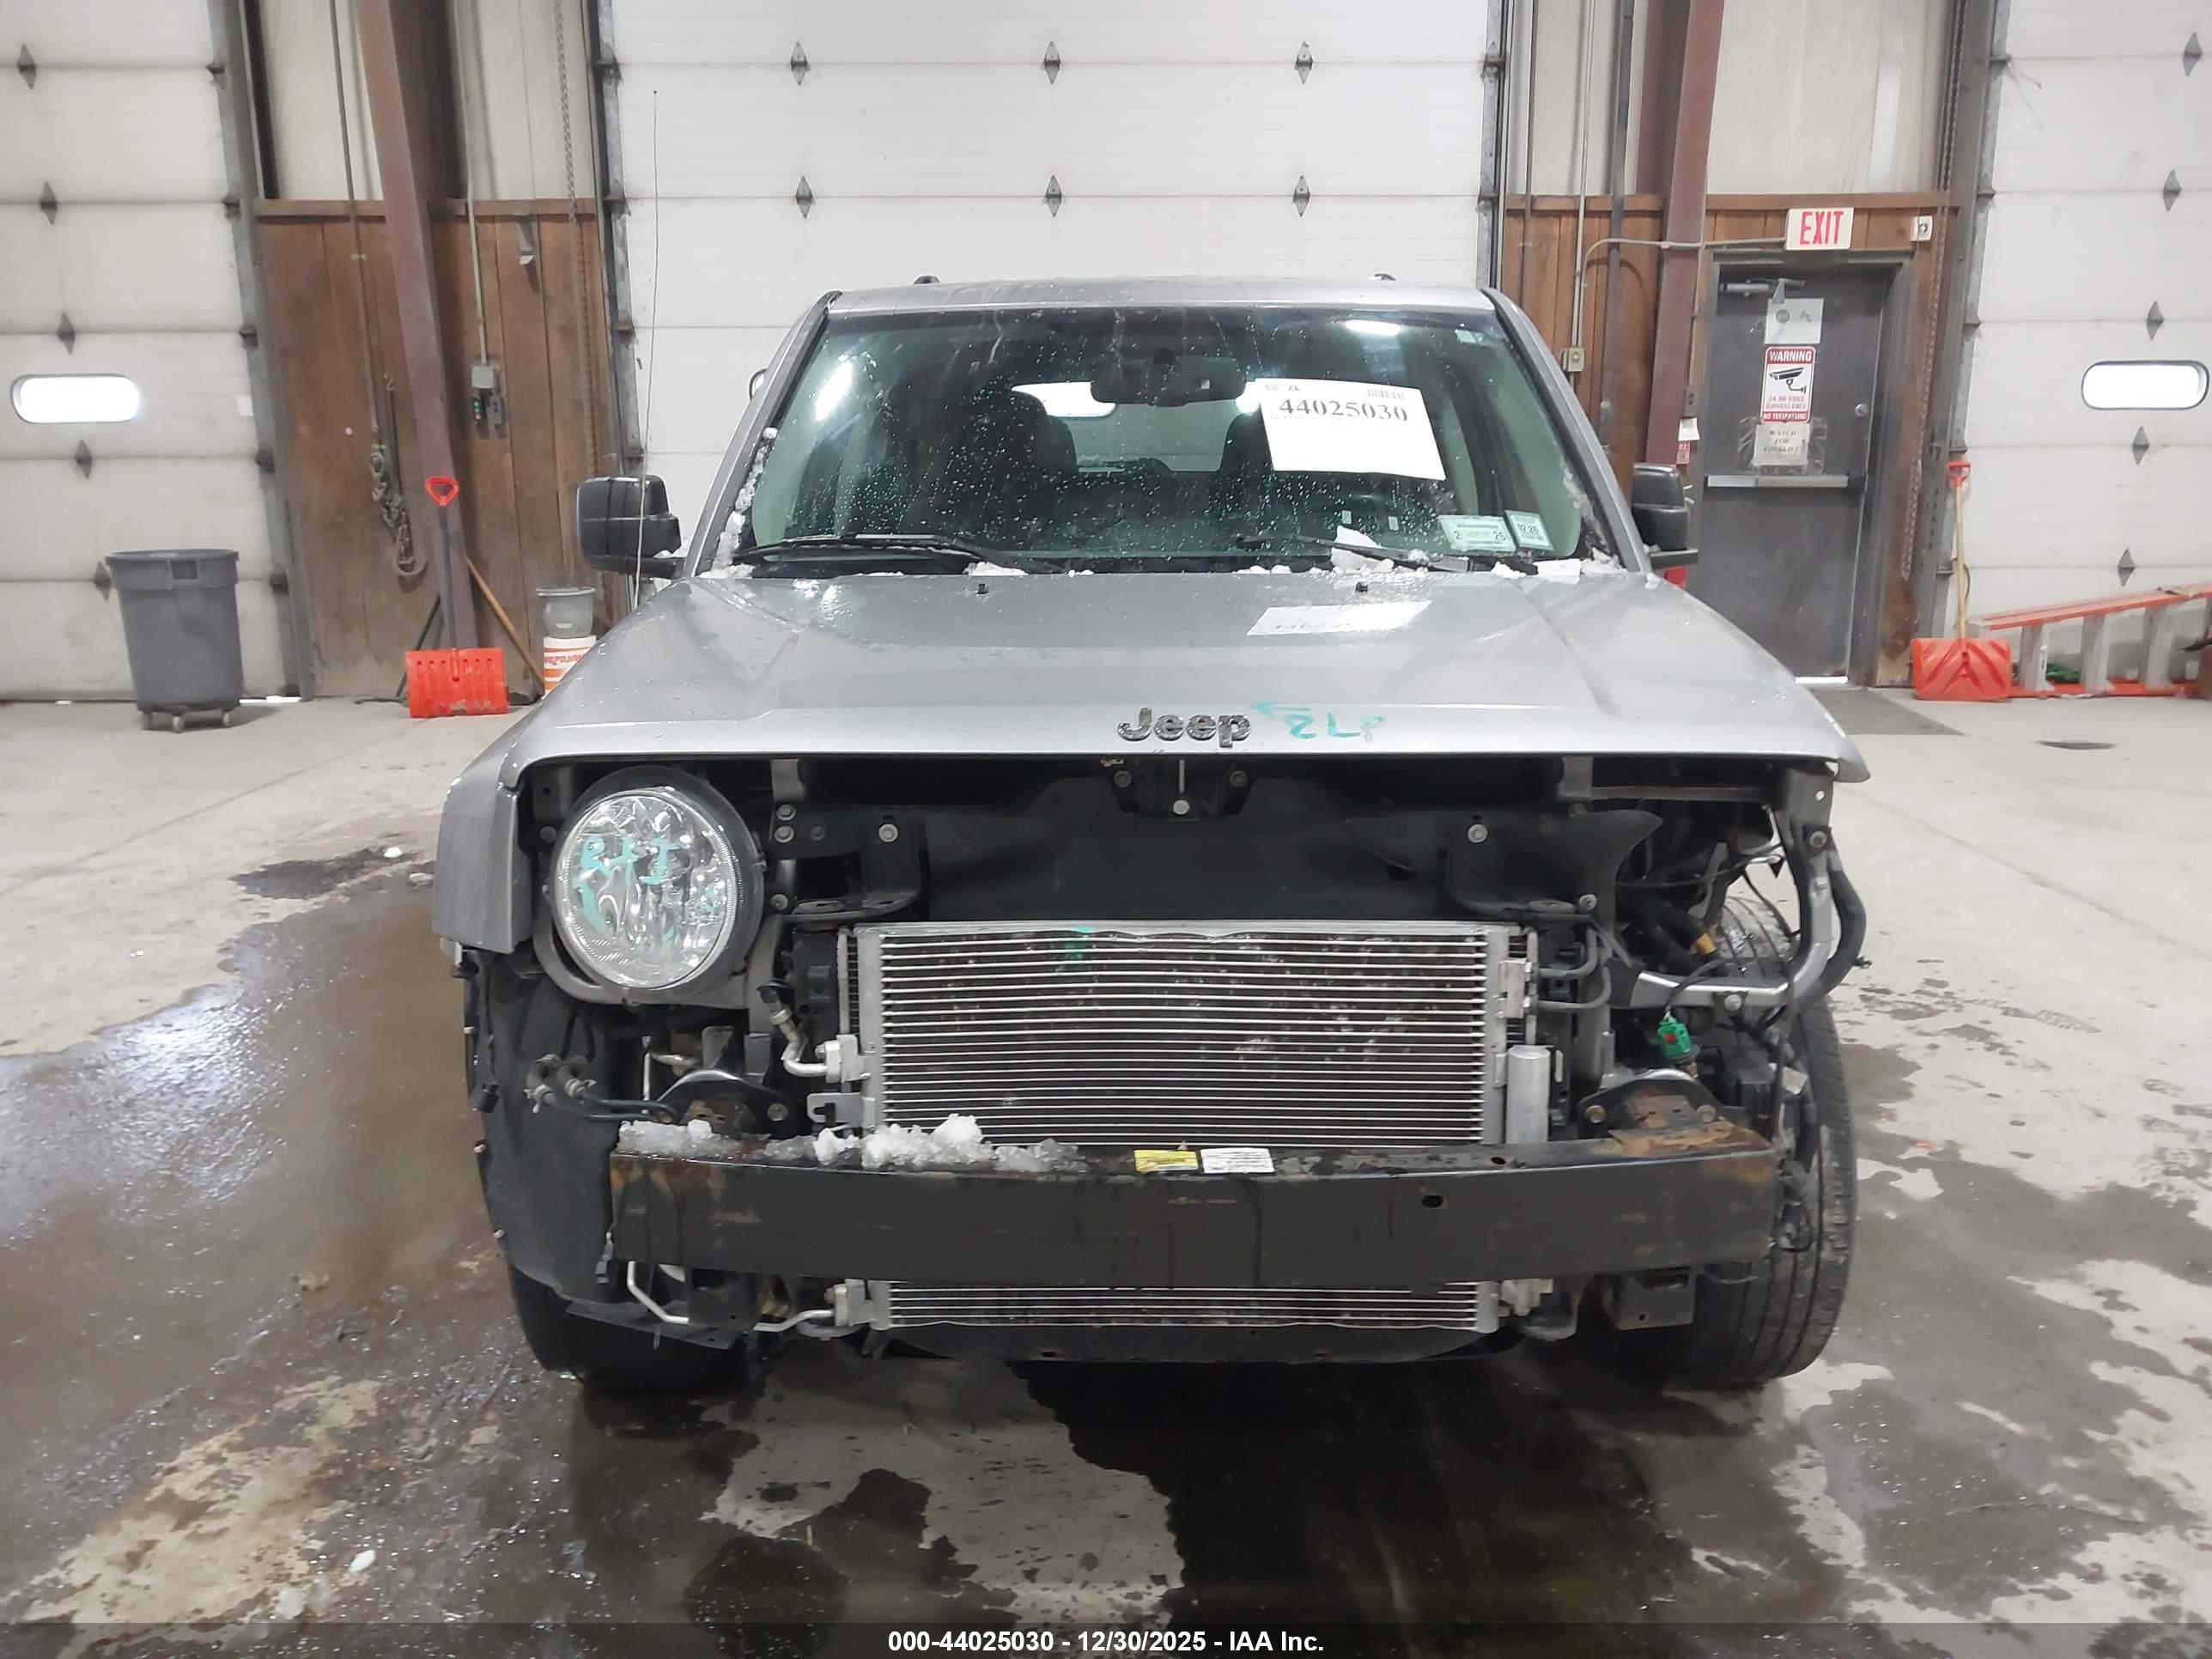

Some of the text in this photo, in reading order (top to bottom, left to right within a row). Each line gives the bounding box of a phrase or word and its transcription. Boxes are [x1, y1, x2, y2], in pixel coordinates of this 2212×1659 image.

[1800, 211, 1844, 245] EXIT
[1769, 349, 1812, 362] WARNING
[1279, 398, 1407, 422] 44025030
[1117, 707, 1250, 749] Jeep
